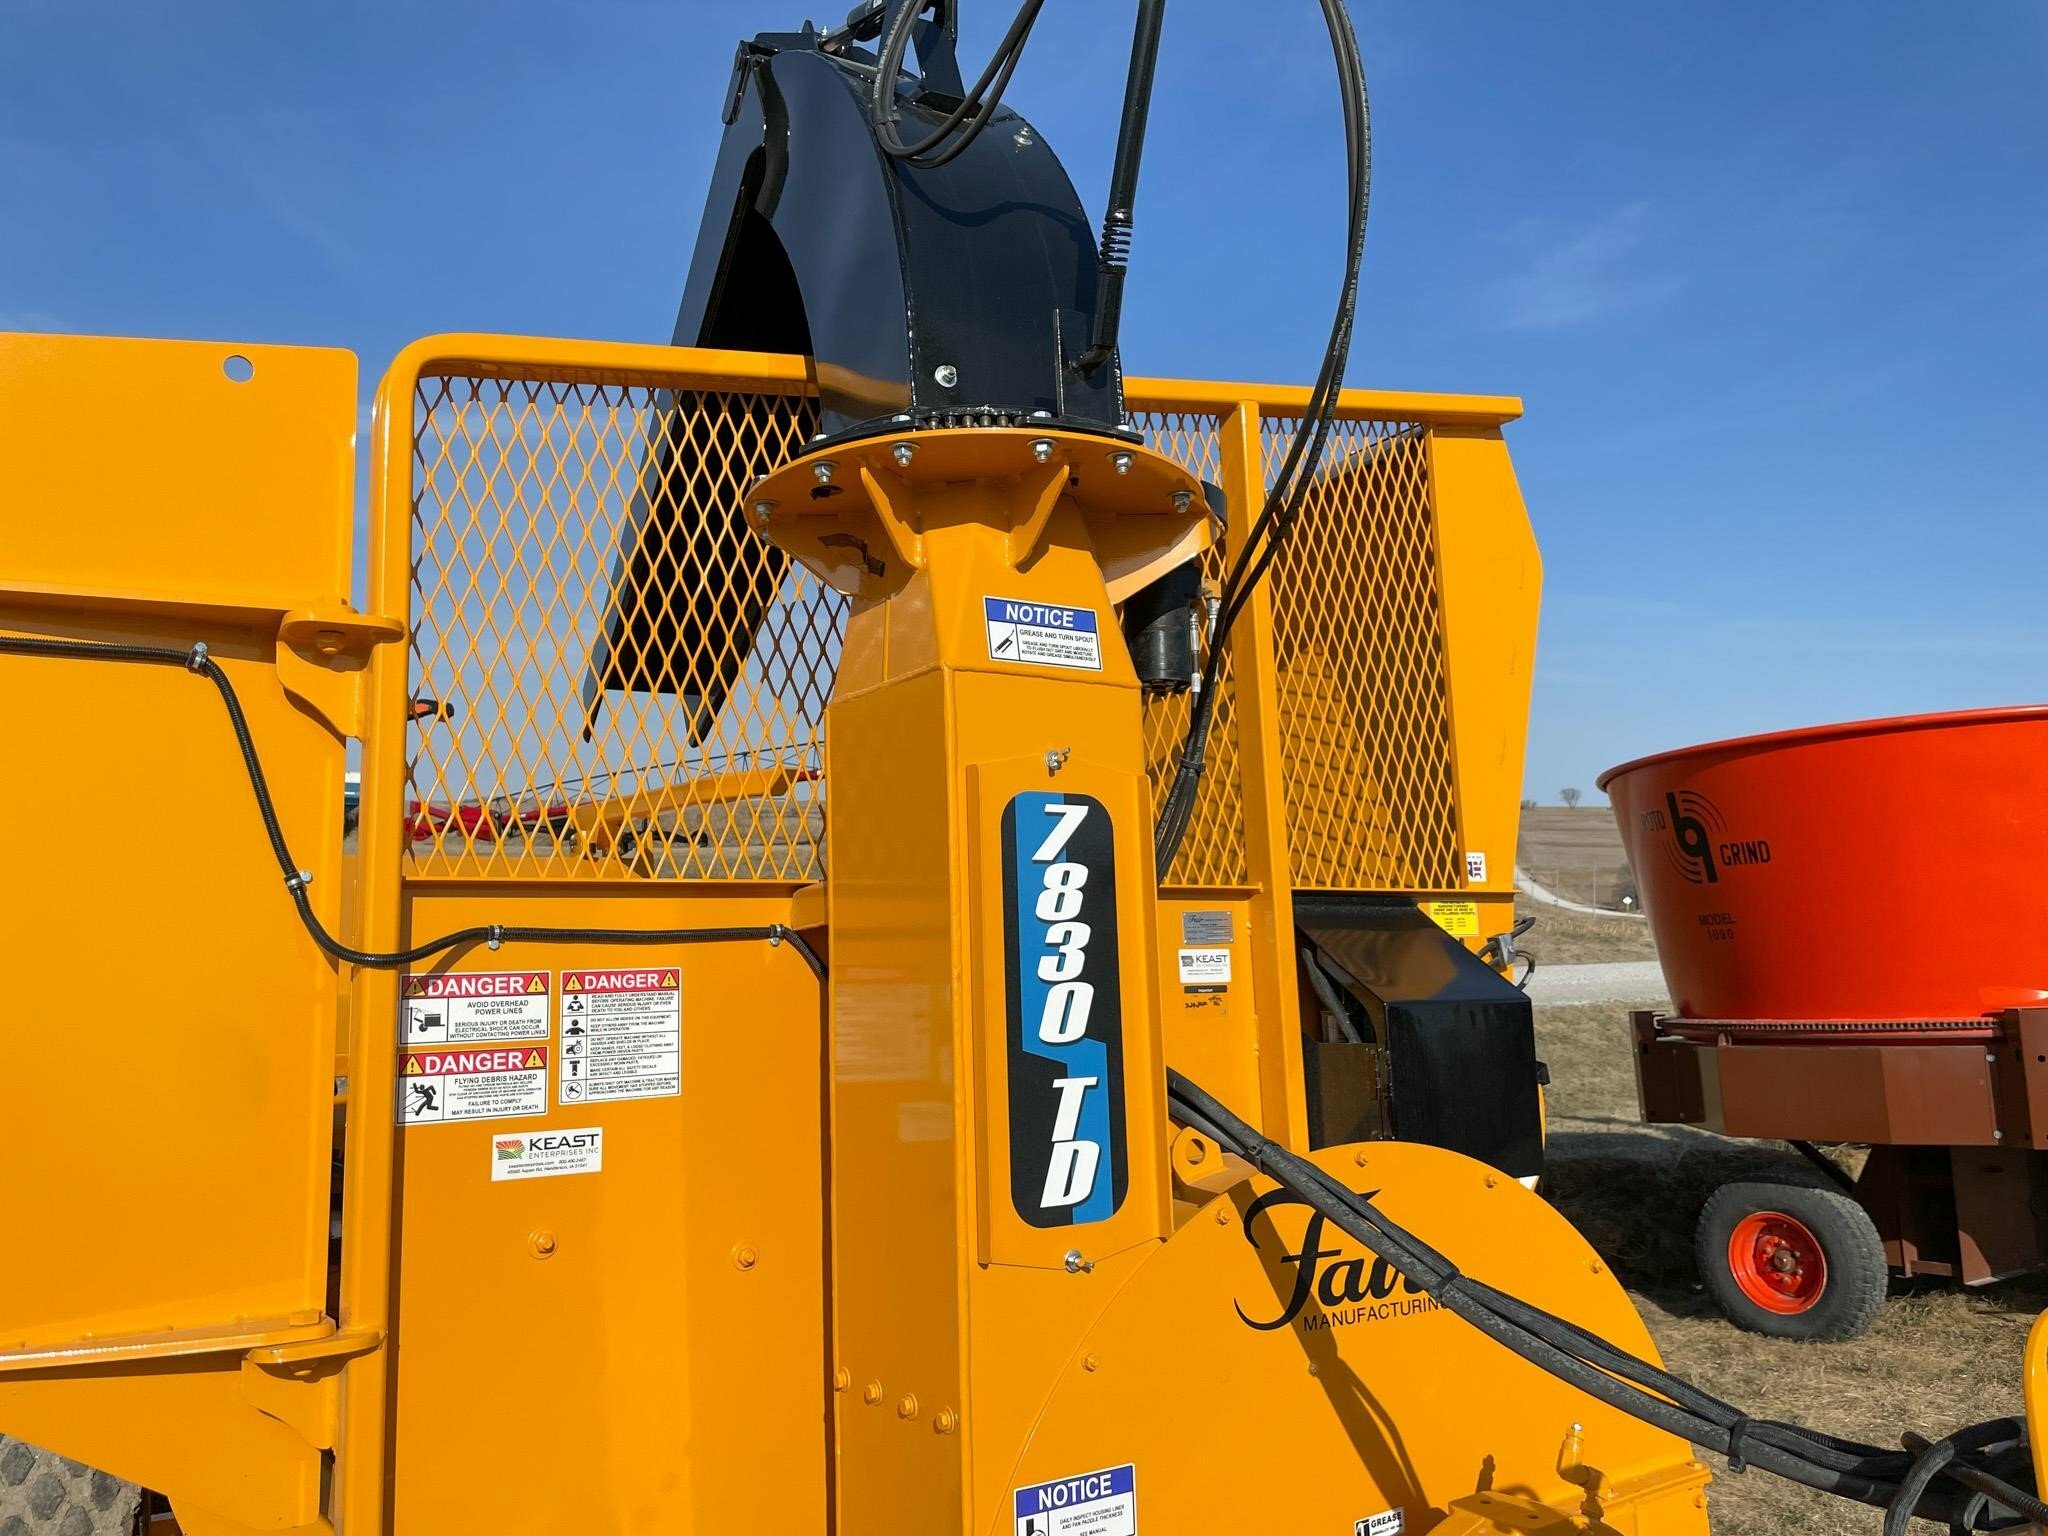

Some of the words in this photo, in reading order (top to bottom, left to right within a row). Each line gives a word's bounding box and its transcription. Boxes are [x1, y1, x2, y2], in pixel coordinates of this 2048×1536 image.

[1006, 604, 1074, 627] NOTICE
[1020, 629, 1043, 637] GREASE
[1720, 840, 1771, 866] GRIND
[1032, 804, 1095, 1044] 7830
[1699, 912, 1736, 926] MODEL
[1196, 955, 1228, 963] KEAST
[427, 977, 526, 996] DANGER
[584, 973, 659, 990] DANGER
[425, 1052, 524, 1074] DANGER
[530, 1134, 599, 1151] KEAST
[1039, 1076, 1100, 1209] TD
[529, 1149, 583, 1159] ENTERPRISES
[1039, 1474, 1112, 1510] NOTICE
[1073, 1512, 1091, 1521] INSPECT
[1092, 1507, 1111, 1515] HOUSING
[1082, 1517, 1098, 1525] PADDLE
[1100, 1511, 1123, 1520] THICKNESS
[1371, 1512, 1401, 1528] GREASE
[1089, 1526, 1107, 1535] MANUAL
